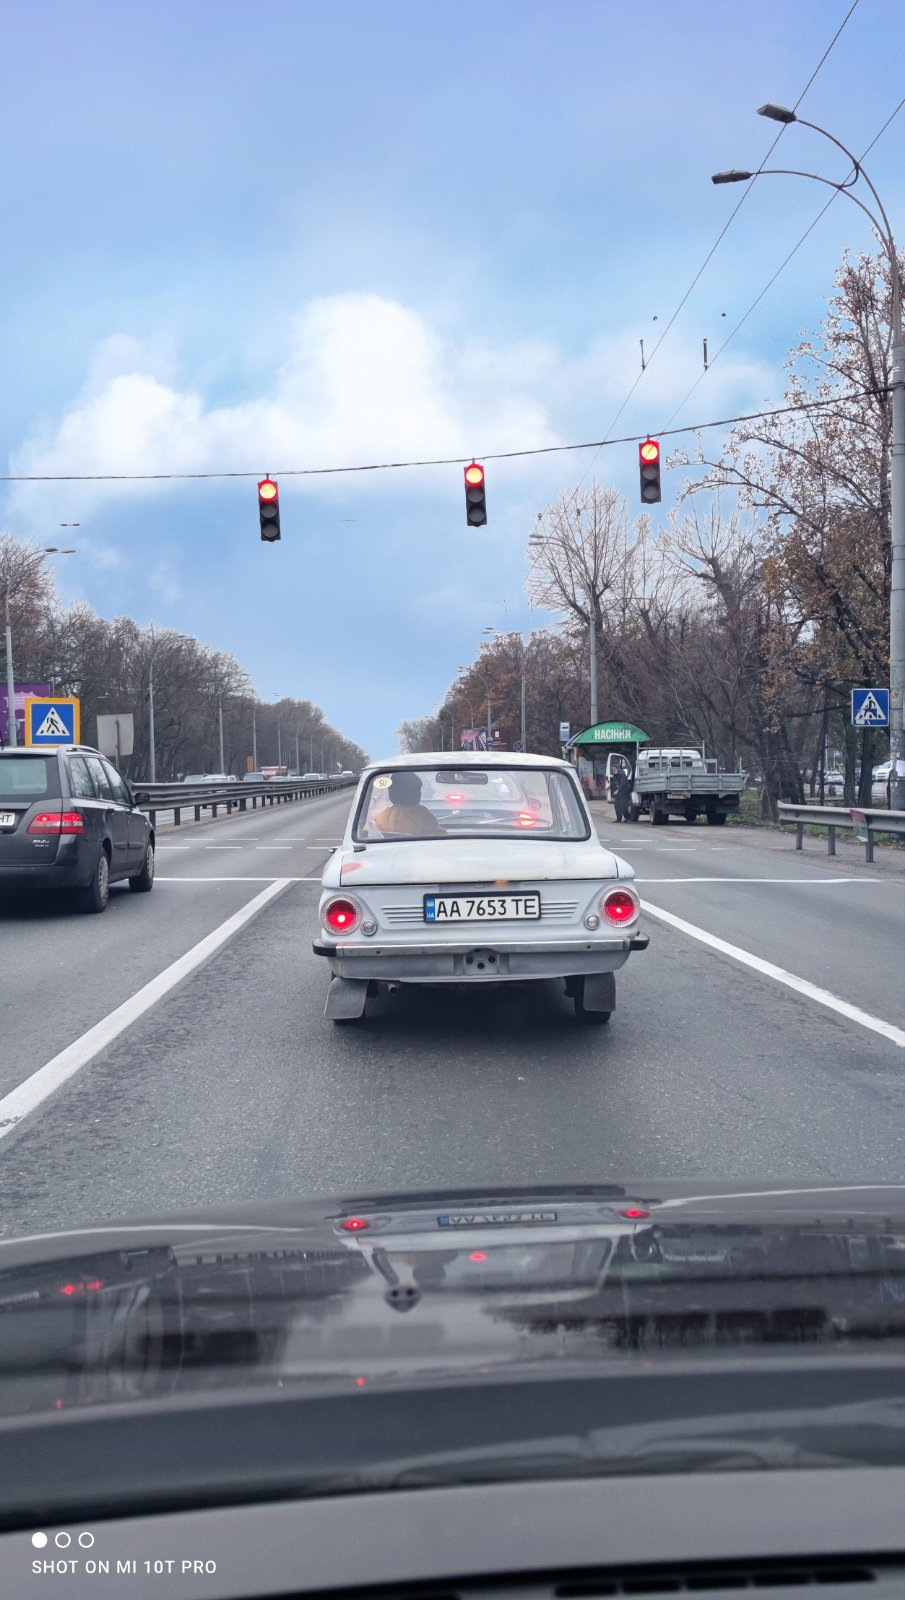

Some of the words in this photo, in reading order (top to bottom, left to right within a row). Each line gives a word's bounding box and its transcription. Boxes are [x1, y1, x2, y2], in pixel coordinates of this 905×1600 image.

[436, 900, 461, 918] AA
[465, 899, 507, 917] 7653
[511, 898, 537, 916] TE
